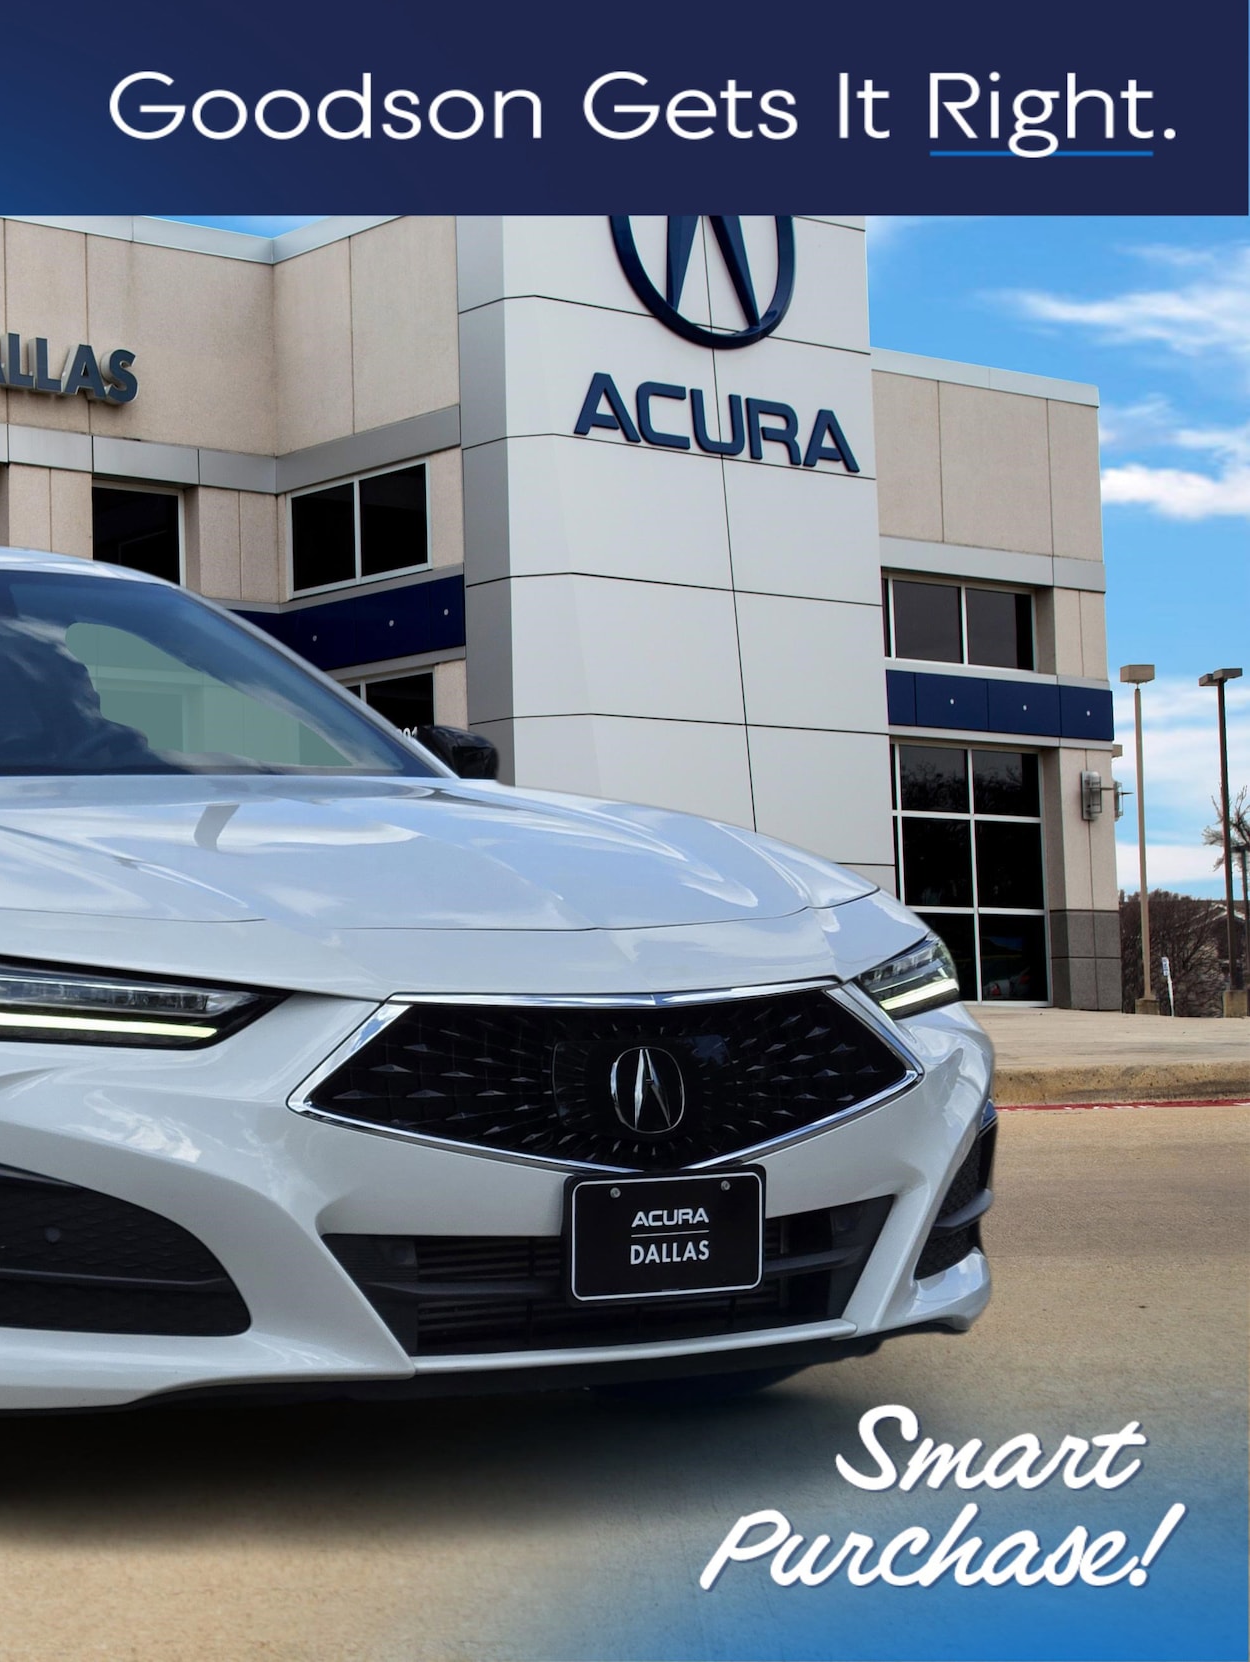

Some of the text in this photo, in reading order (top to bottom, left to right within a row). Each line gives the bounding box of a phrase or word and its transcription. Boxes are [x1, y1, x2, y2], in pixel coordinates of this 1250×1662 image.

[574, 371, 860, 474] ACURA
[631, 1207, 710, 1228] ACURA
[630, 1240, 710, 1265] DALLAS
